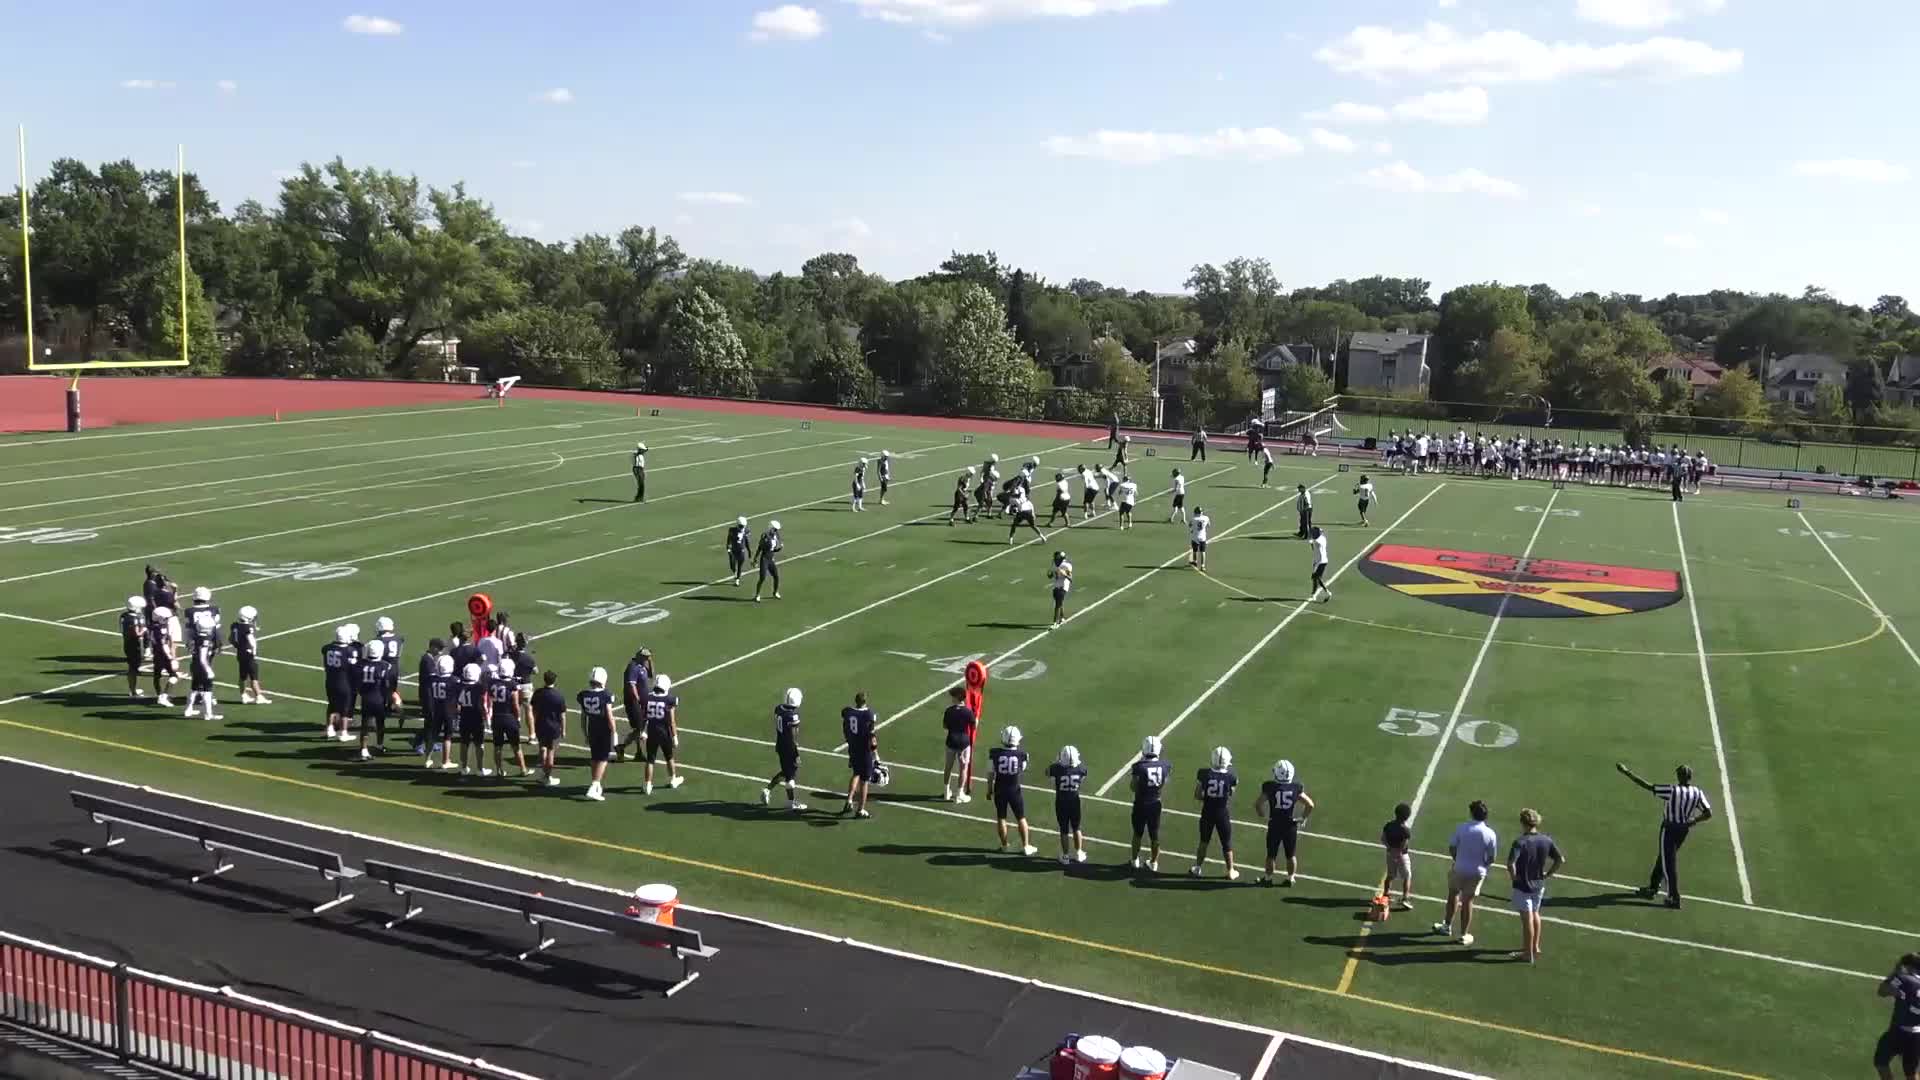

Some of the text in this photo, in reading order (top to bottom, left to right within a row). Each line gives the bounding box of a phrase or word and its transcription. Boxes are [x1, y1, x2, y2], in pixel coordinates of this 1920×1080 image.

[556, 601, 670, 625] 30
[388, 641, 398, 657] 9
[363, 666, 375, 683] 11
[432, 682, 447, 699] 16
[459, 690, 473, 707] 41
[849, 716, 858, 734] 8
[1378, 708, 1519, 748] 50
[999, 756, 1019, 775] 20
[1059, 775, 1080, 791] 25
[1147, 767, 1163, 786] 51
[1207, 780, 1225, 798] 21
[1275, 791, 1293, 809] 15
